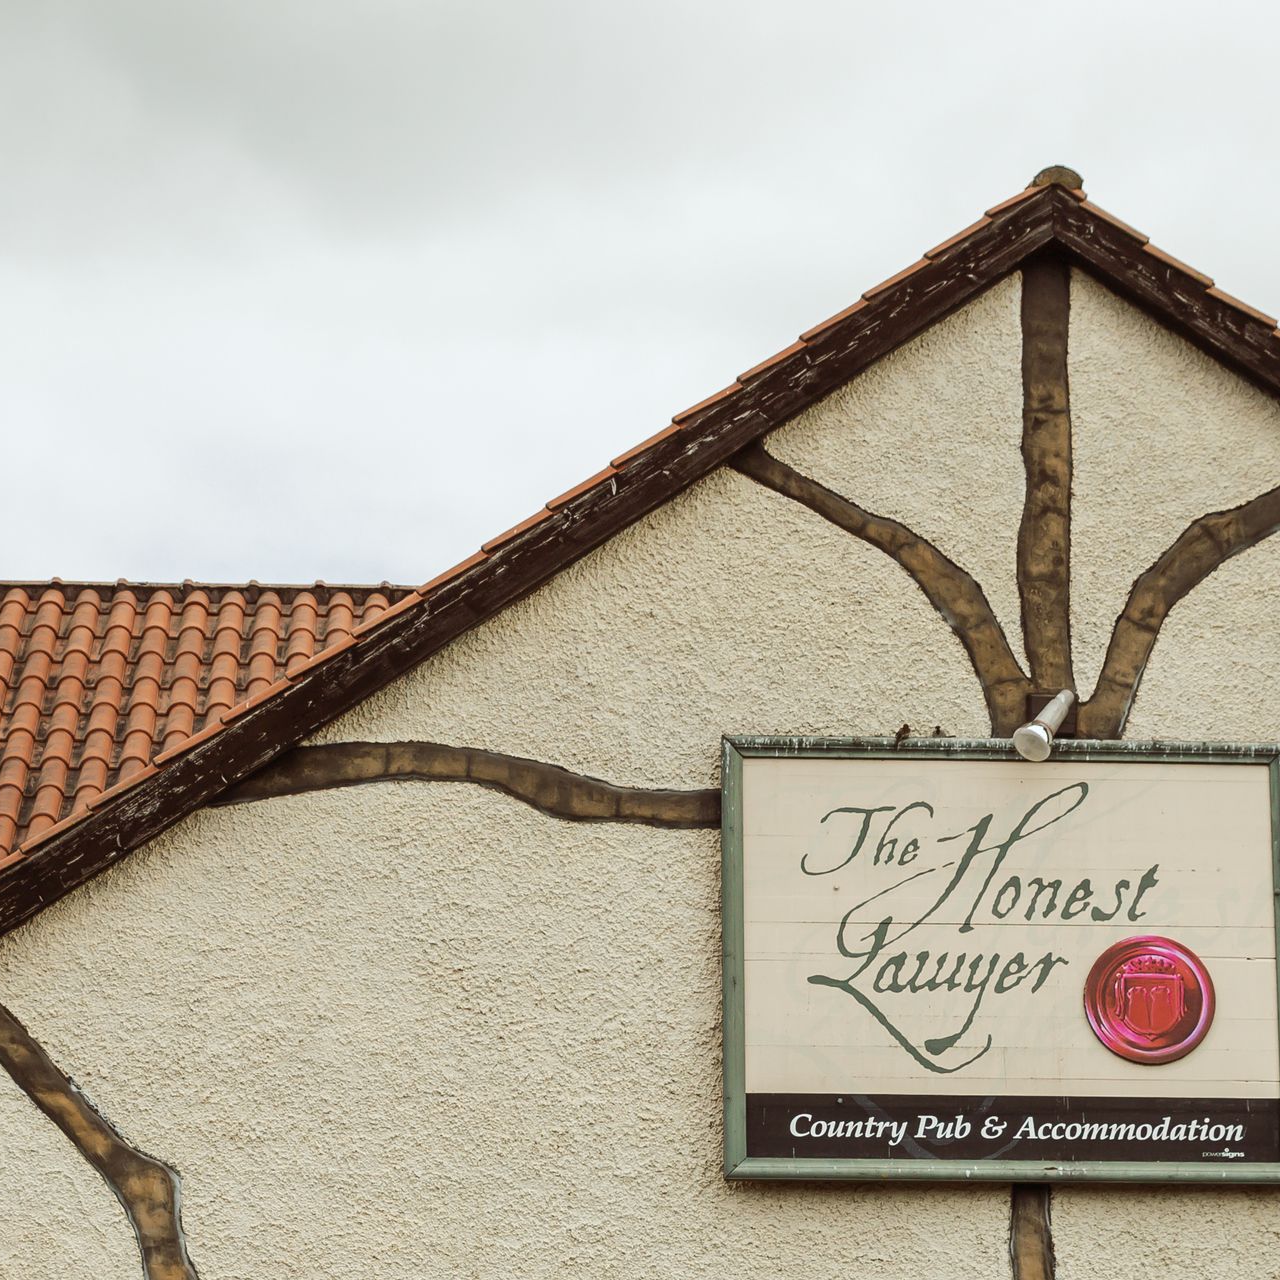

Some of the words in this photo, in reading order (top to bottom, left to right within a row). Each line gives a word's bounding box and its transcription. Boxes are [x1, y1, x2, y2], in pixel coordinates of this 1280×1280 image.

[801, 802, 934, 875] The
[865, 782, 1159, 945] Honest
[808, 862, 1069, 1073] Lawyer
[789, 1113, 907, 1145] Country
[915, 1114, 972, 1141] Pub
[980, 1115, 1007, 1140] &
[1013, 1116, 1244, 1142] Accommodation
